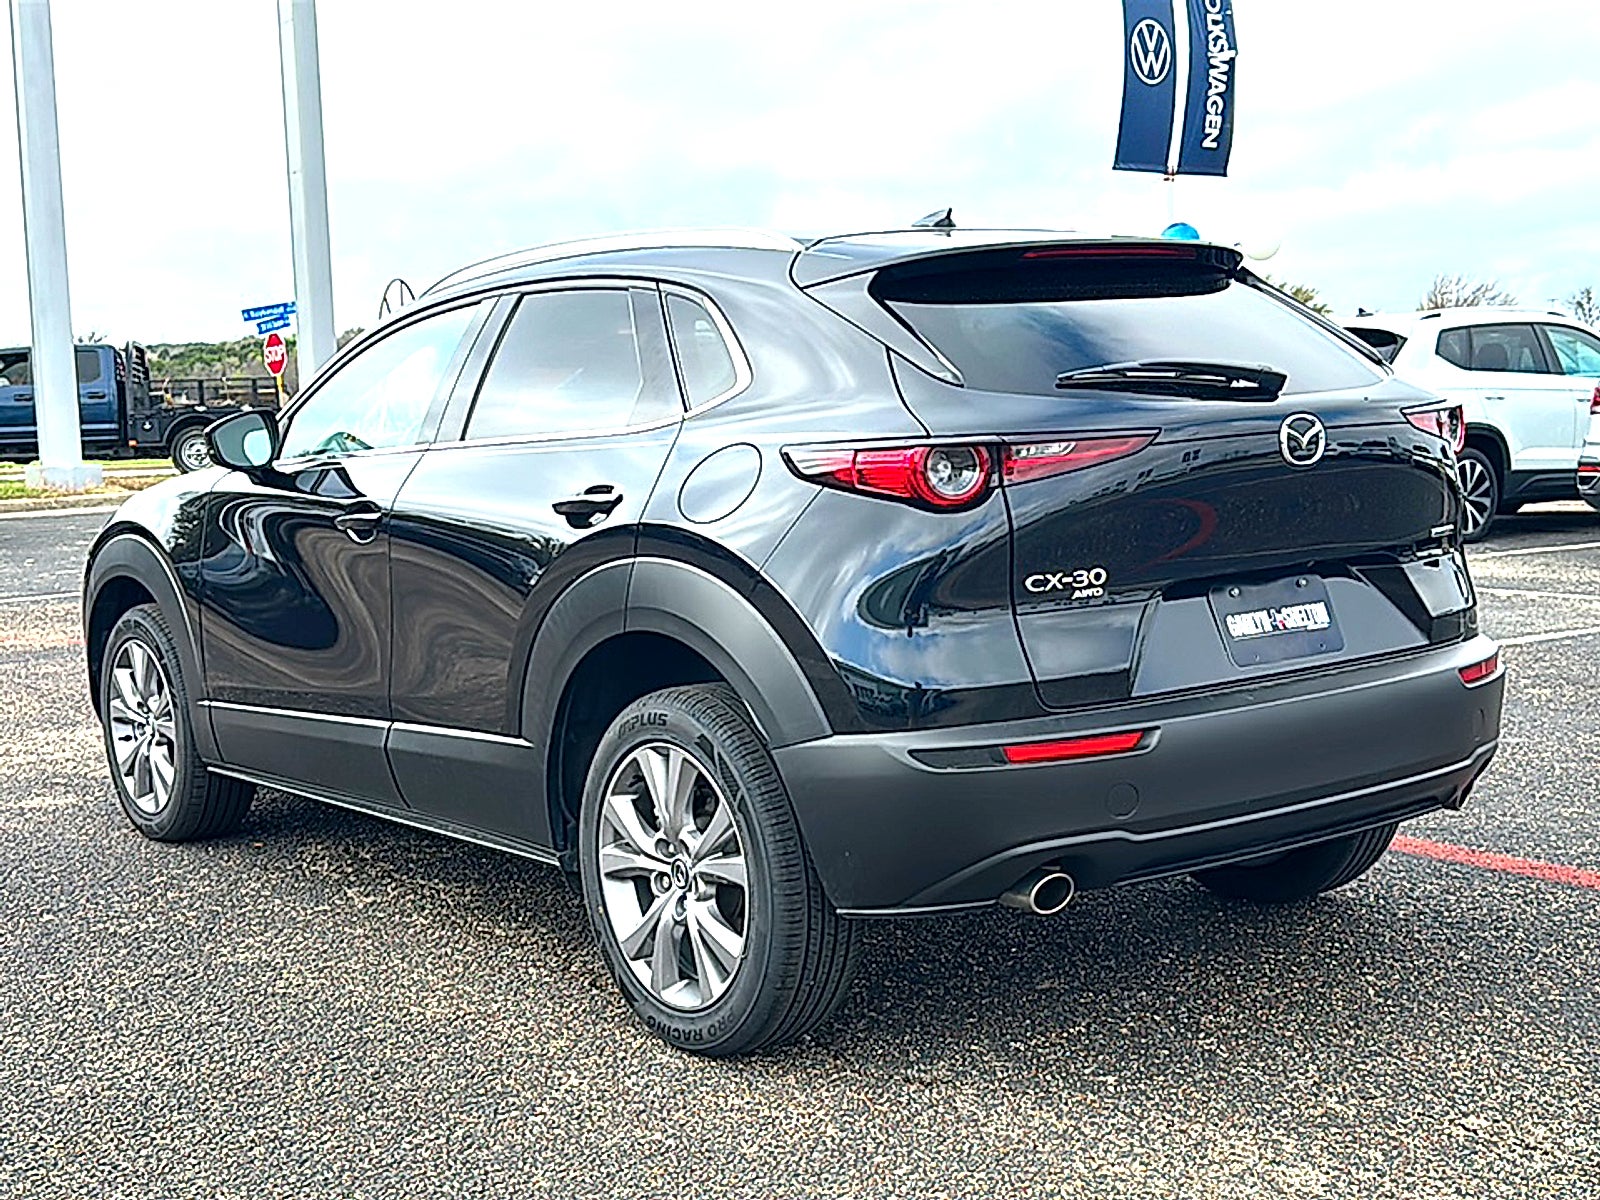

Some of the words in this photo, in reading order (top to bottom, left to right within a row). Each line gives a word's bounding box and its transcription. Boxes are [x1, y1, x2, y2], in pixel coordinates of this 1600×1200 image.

[265, 345, 284, 363] STOP
[1025, 568, 1107, 592] CX-30
[1071, 587, 1104, 600] AWD
[646, 1015, 703, 1041] RACING
